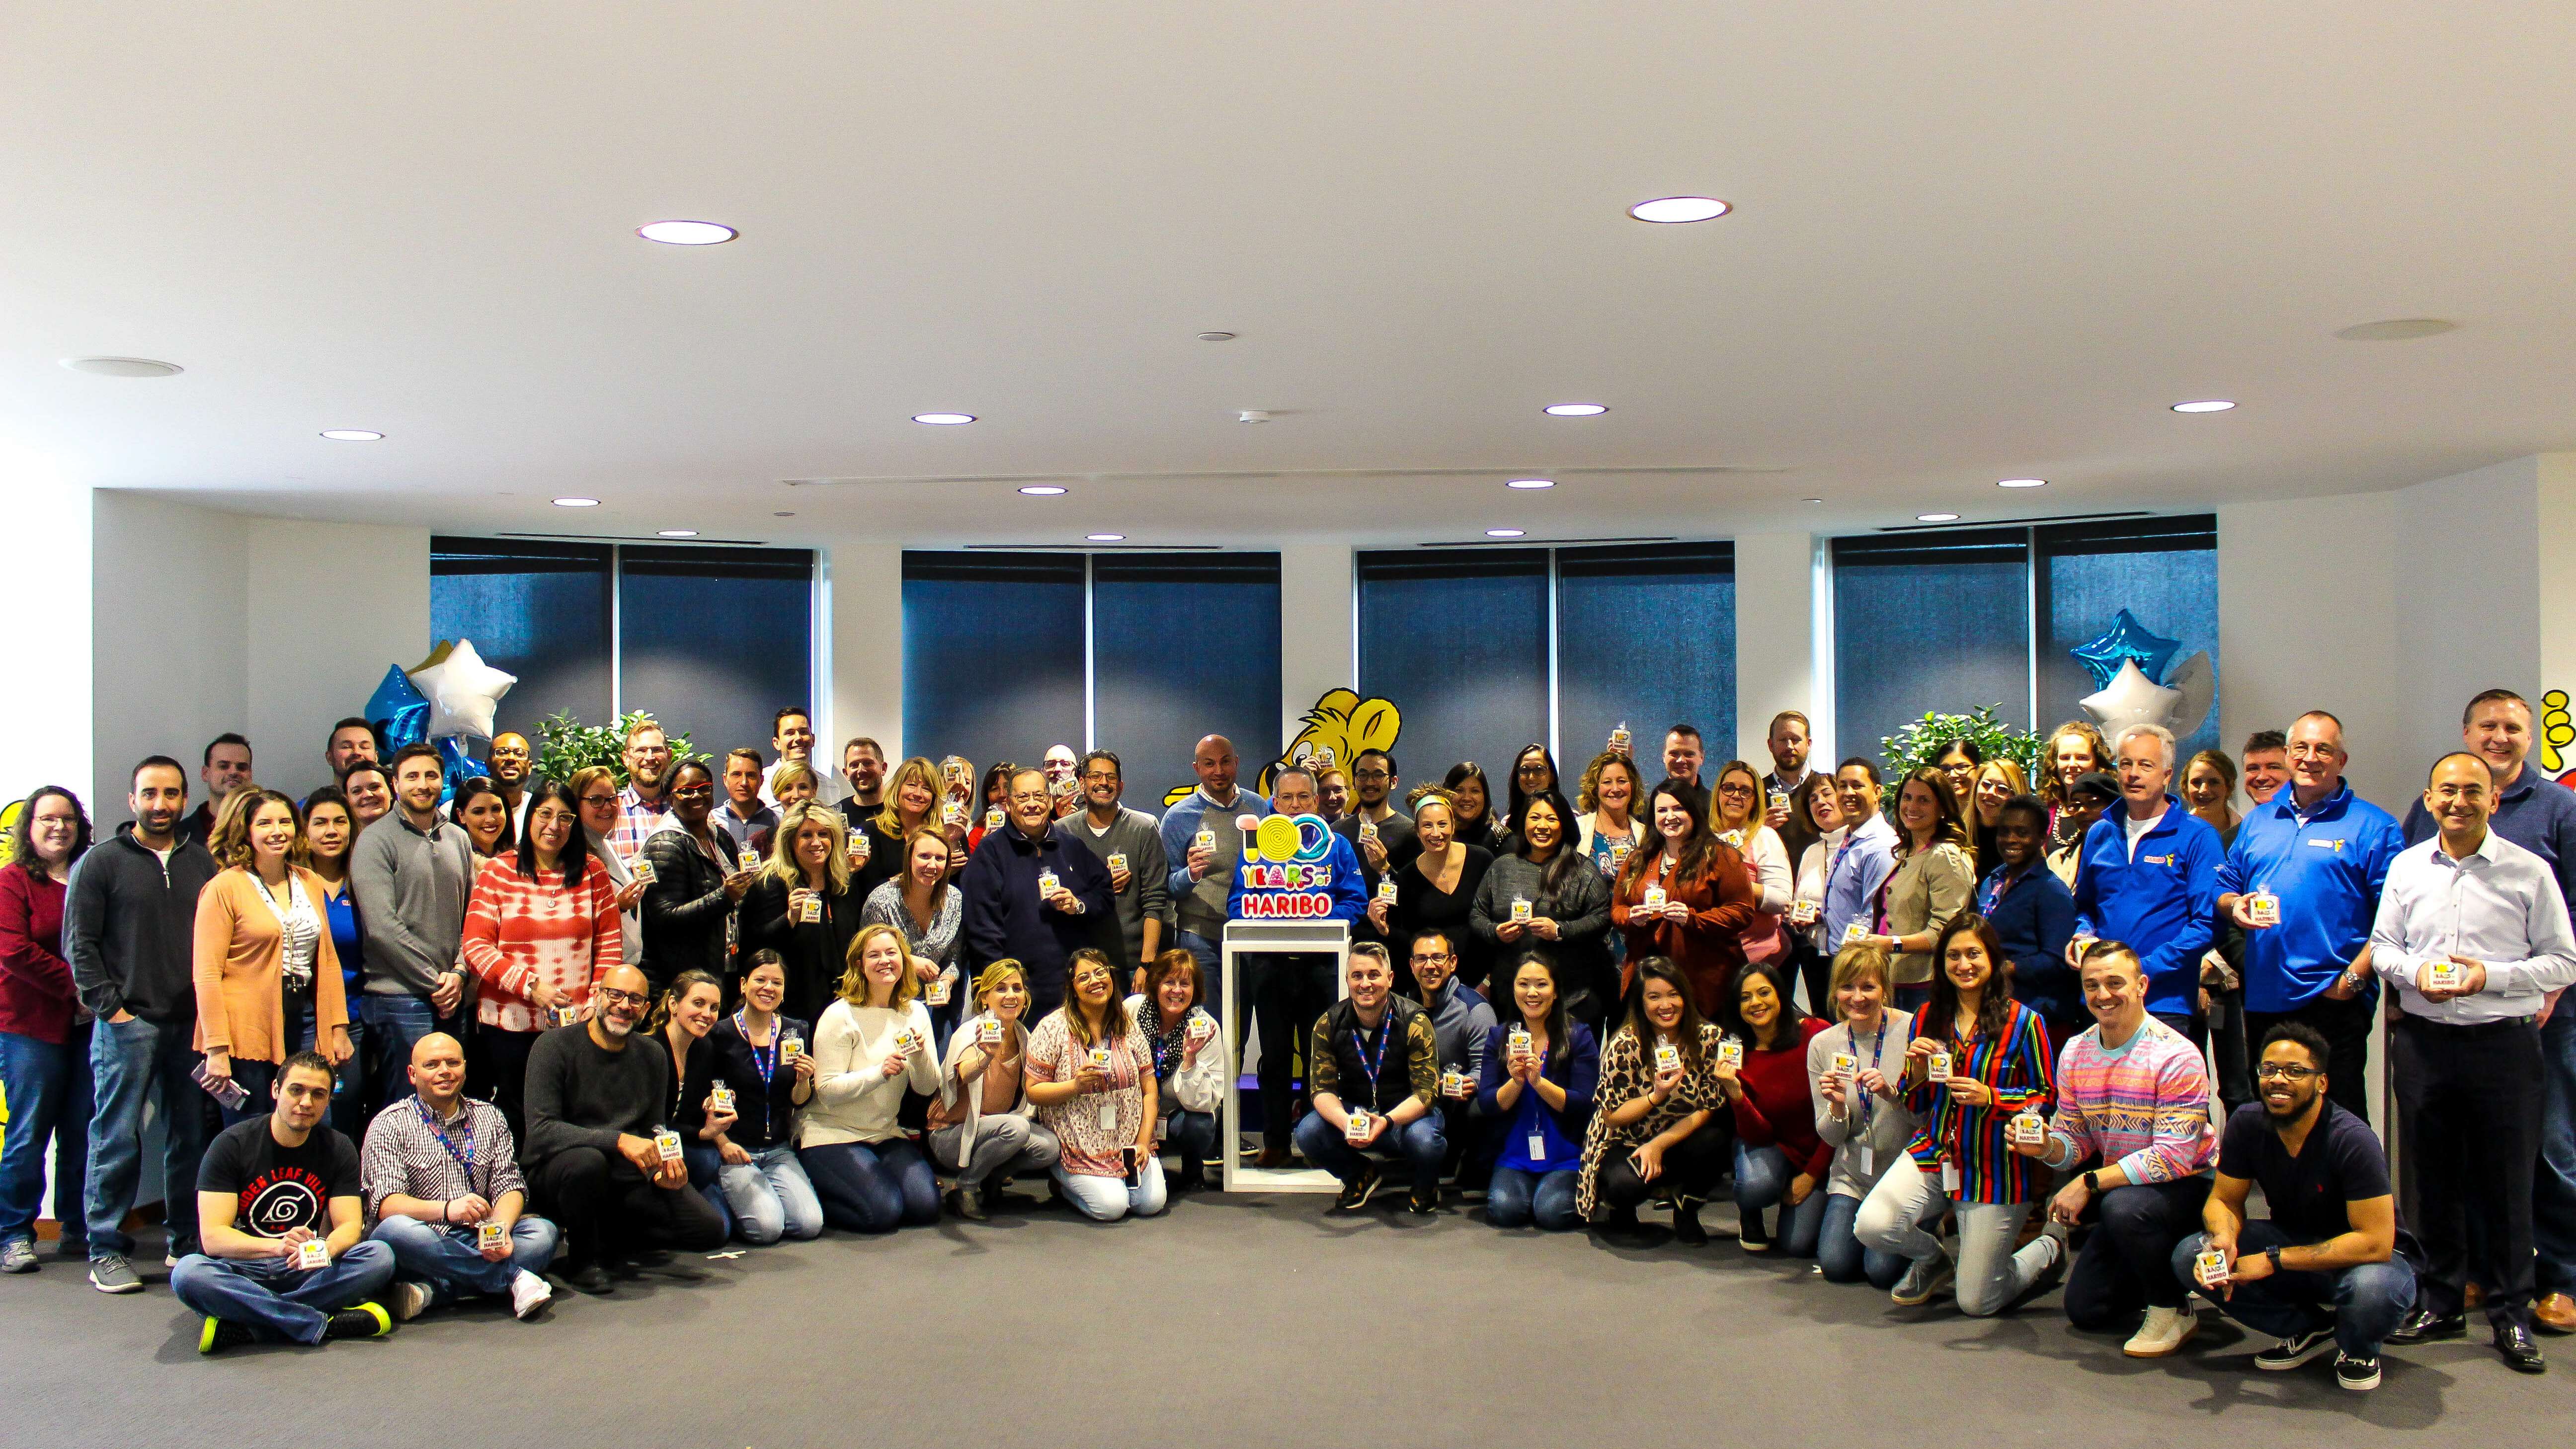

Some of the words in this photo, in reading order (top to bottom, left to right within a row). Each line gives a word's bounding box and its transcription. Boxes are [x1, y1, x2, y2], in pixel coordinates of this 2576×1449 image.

[1237, 815, 1333, 862] 100
[1242, 865, 1315, 889] YEARS
[1316, 875, 1331, 886] OF
[1243, 894, 1331, 915] HARIBO
[271, 1166, 303, 1182] LEAF
